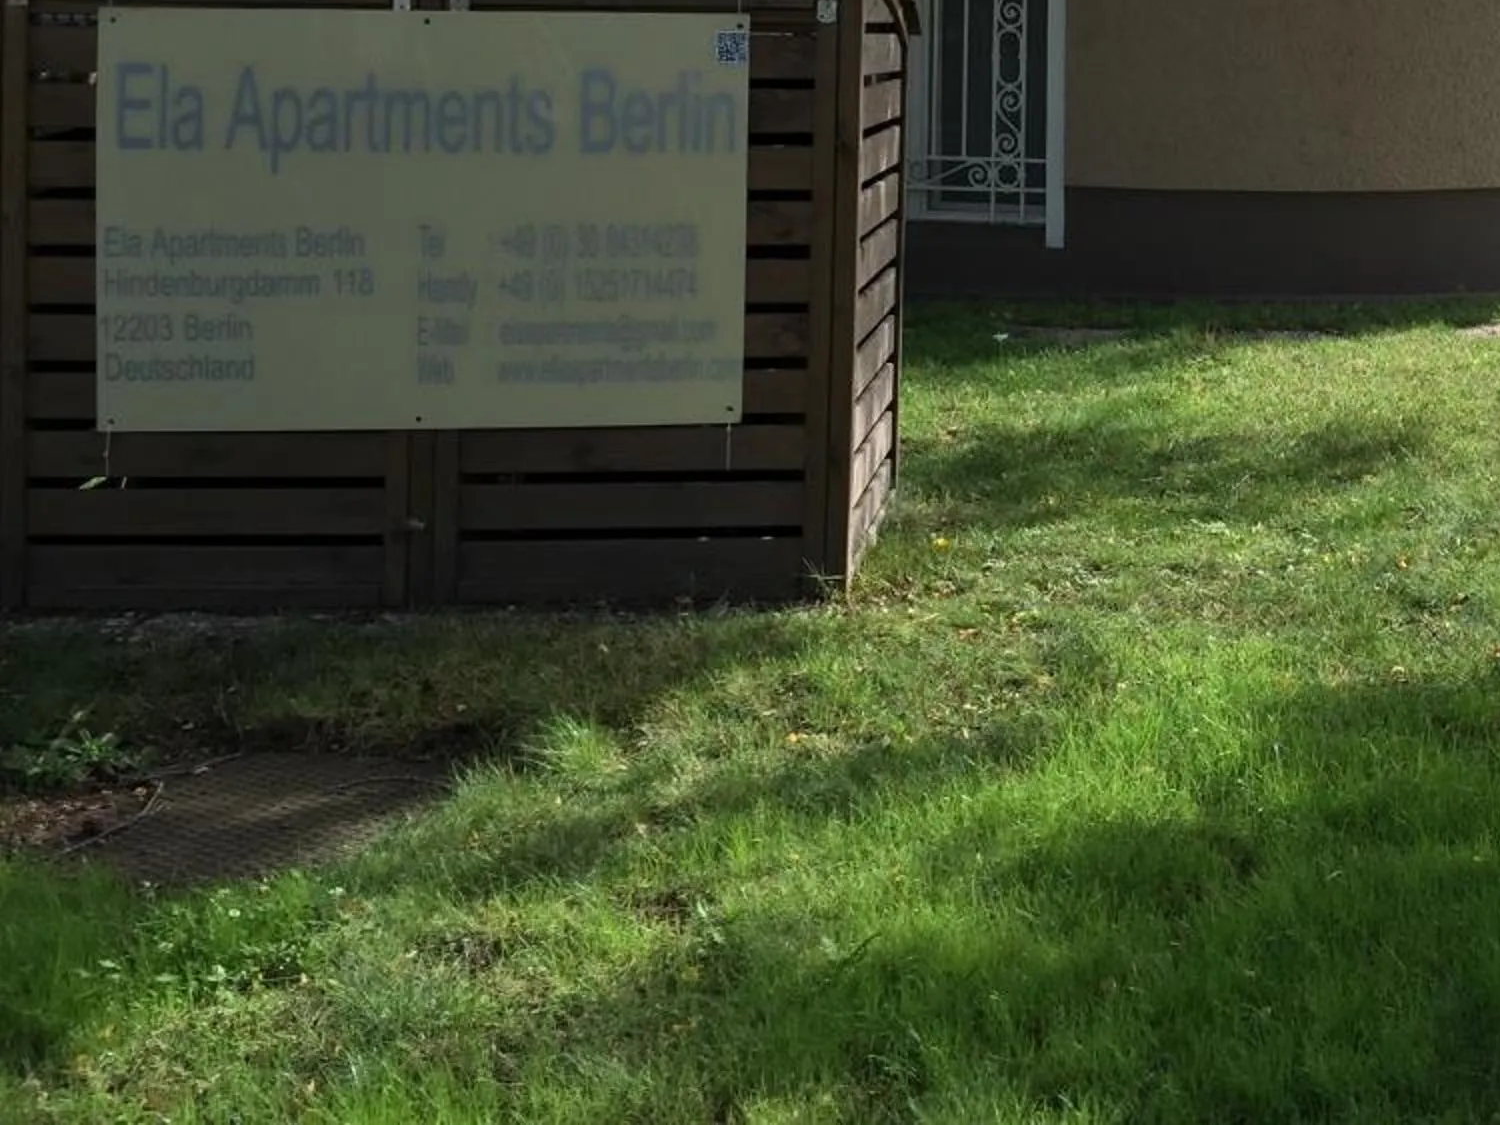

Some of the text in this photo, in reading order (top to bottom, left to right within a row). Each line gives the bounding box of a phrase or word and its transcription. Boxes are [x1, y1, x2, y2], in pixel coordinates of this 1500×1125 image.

[115, 62, 736, 174] Ela Apartments Berlin
[104, 226, 366, 264] Ela Apartments Berlin
[103, 268, 375, 303] Hindenburgdamm 118
[101, 313, 254, 342] 12203 Berlin
[104, 352, 256, 382] Deutschland
